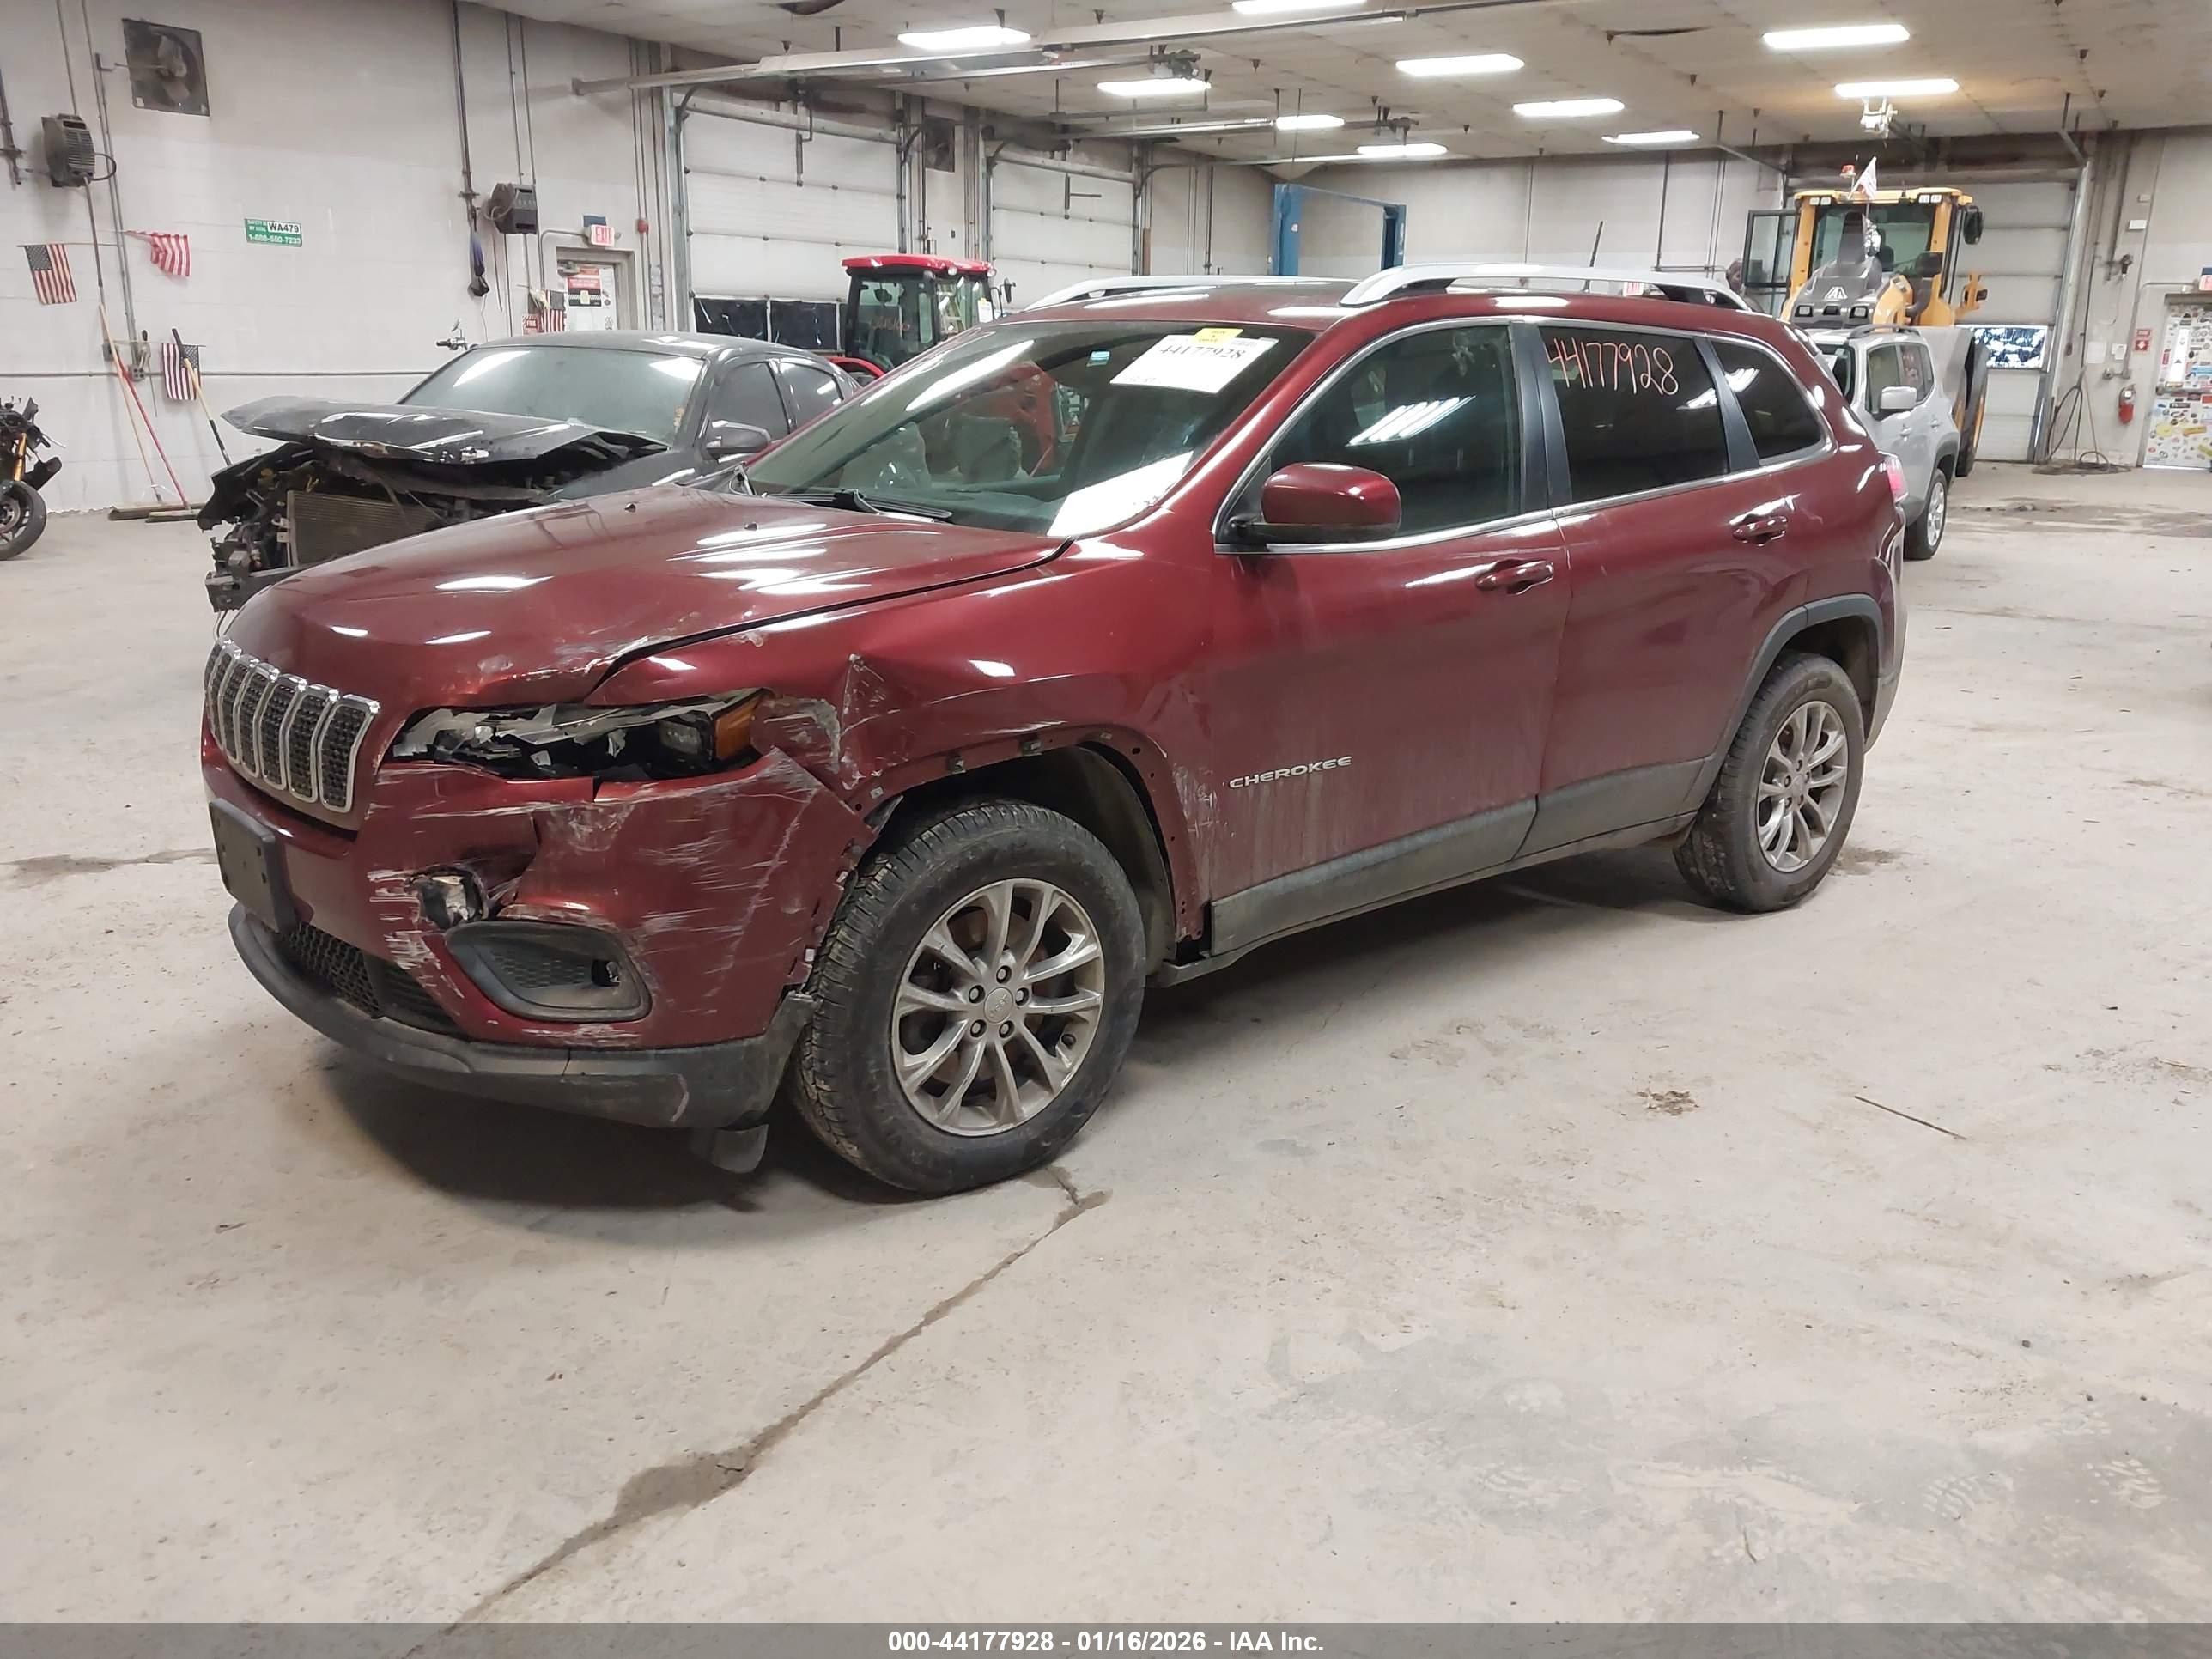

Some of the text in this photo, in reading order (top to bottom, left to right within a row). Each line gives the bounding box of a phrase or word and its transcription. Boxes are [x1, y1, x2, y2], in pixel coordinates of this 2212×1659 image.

[269, 222, 299, 233] WA479
[595, 227, 612, 243] EXIT
[1160, 343, 1246, 360] 44177928
[1545, 337, 1679, 395] 44177928
[1229, 756, 1352, 788] CHEROKEE
